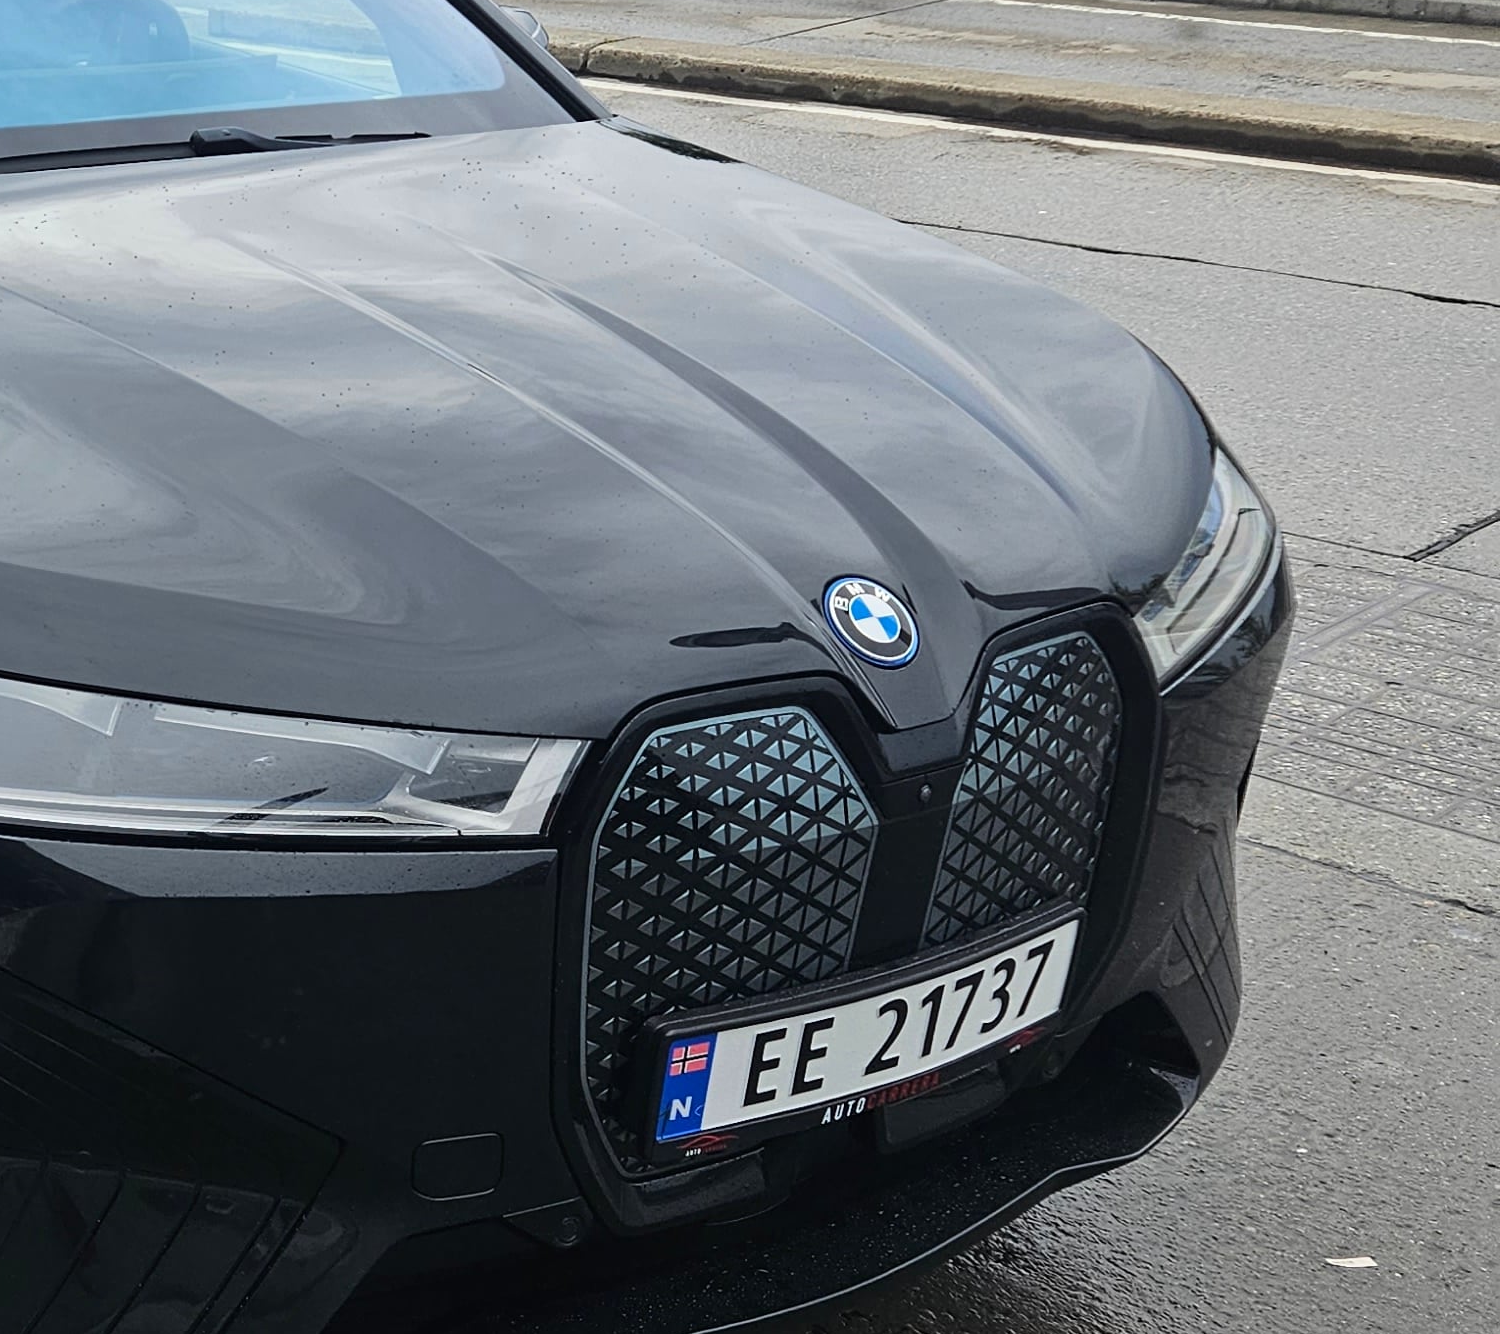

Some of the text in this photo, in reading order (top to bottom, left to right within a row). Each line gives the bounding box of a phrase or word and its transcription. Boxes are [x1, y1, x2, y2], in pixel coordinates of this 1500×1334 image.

[834, 582, 892, 612] BMW
[742, 939, 1055, 1107] EE 21737
[668, 1095, 693, 1121] N
